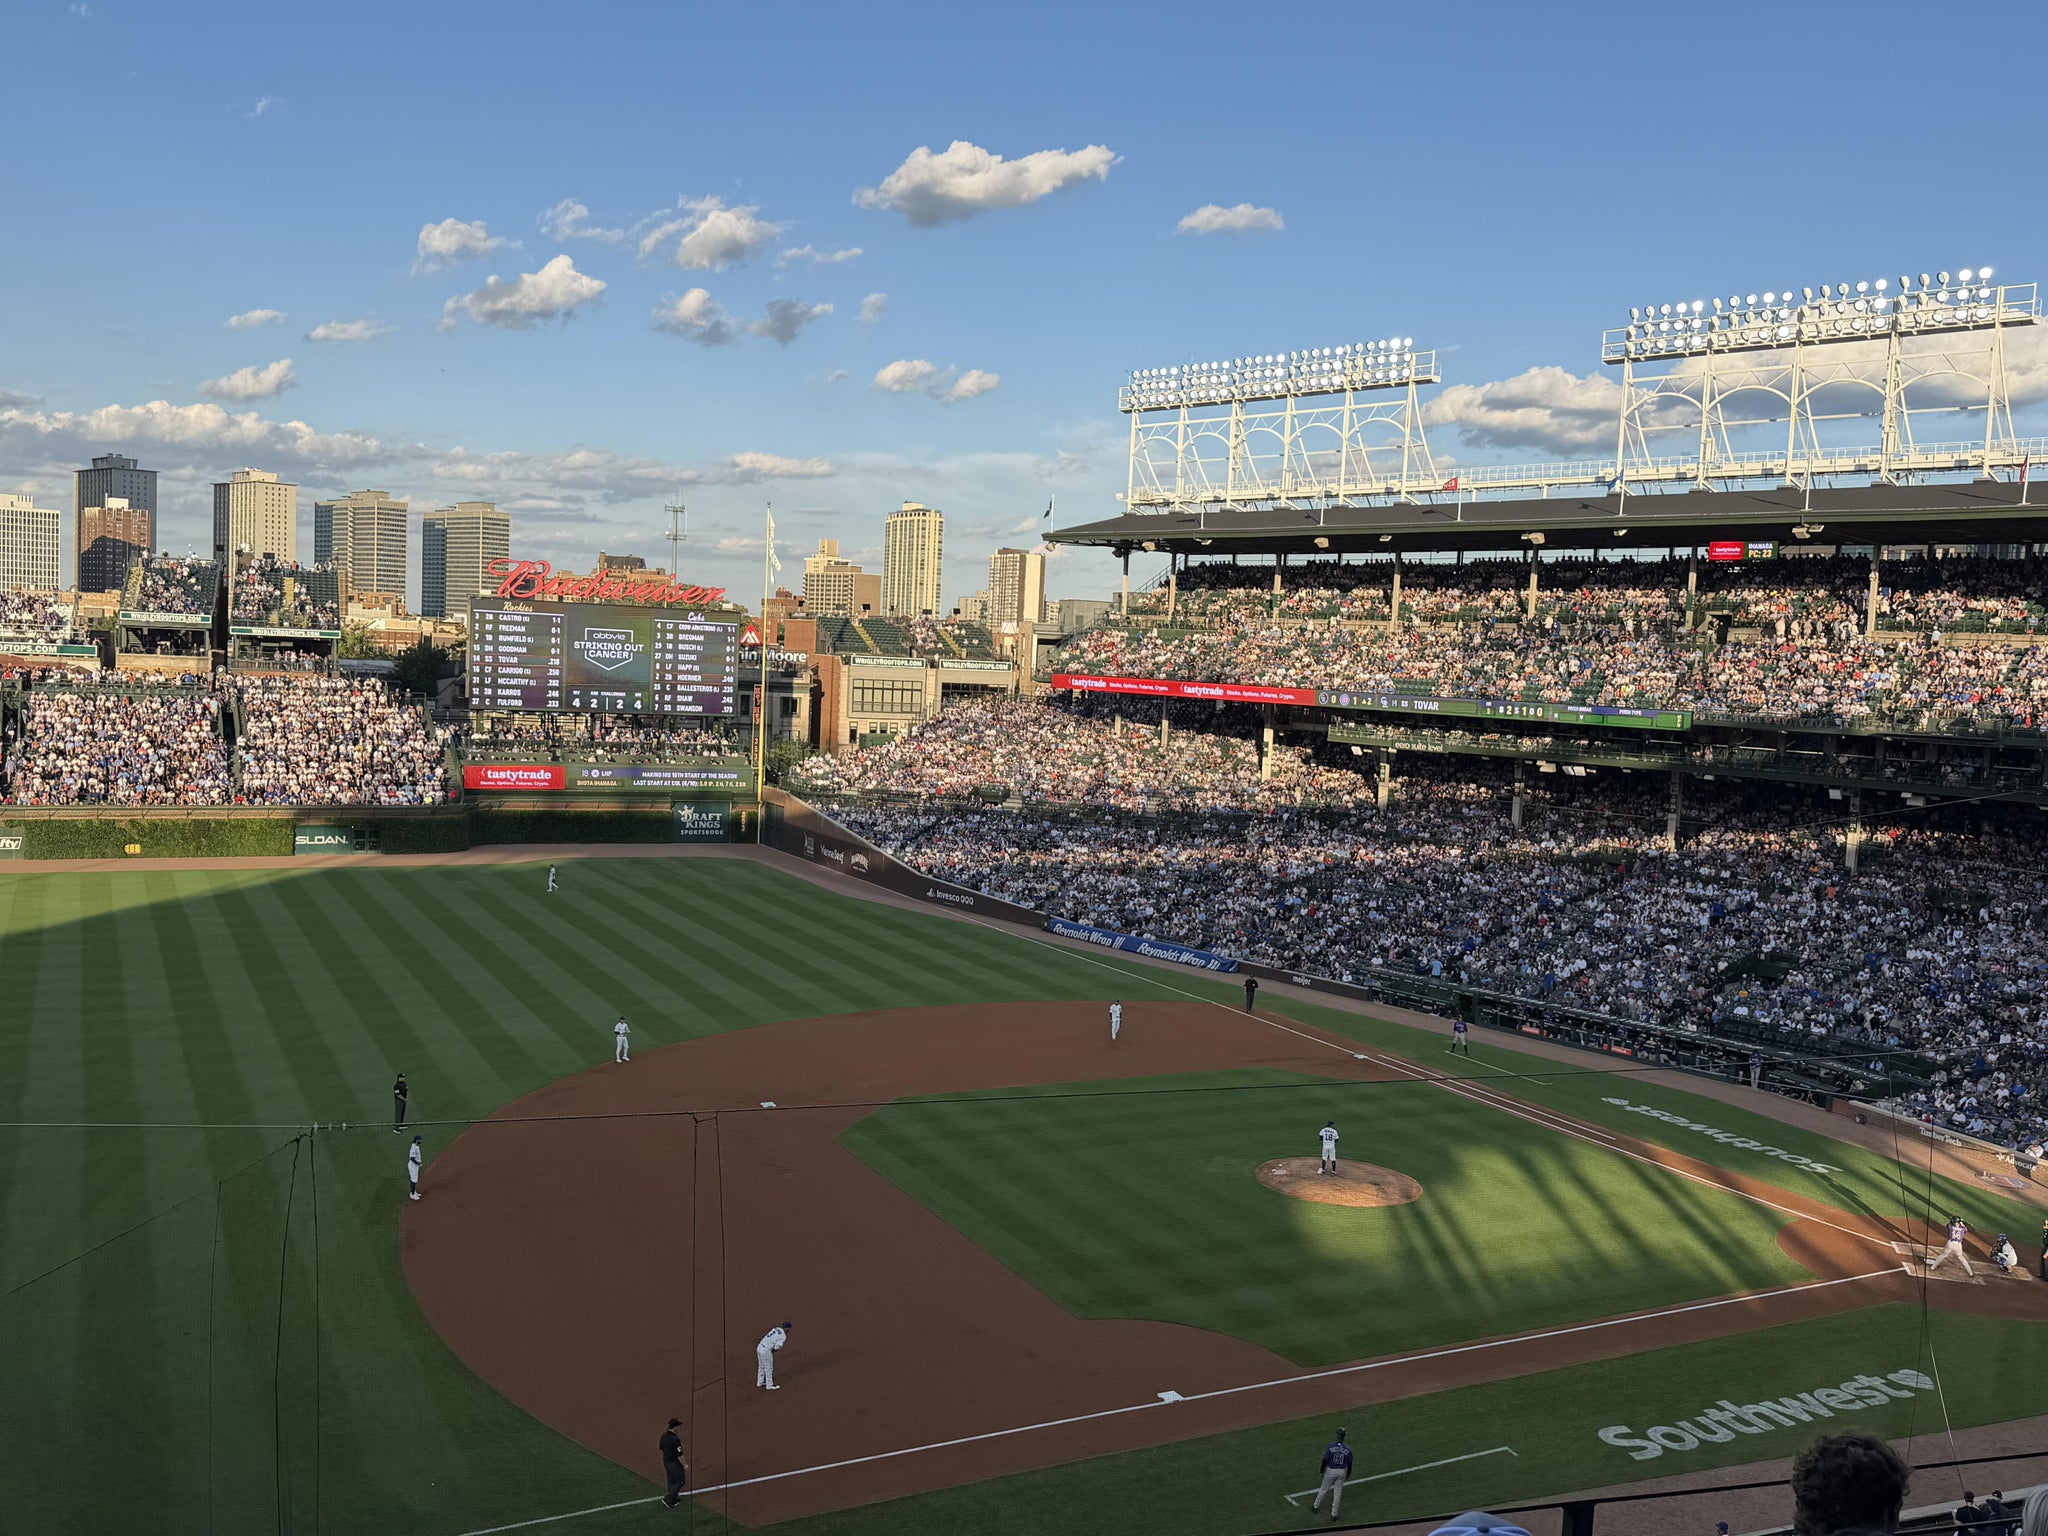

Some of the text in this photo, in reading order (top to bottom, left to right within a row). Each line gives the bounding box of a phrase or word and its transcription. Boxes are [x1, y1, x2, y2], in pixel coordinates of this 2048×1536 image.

[487, 558, 726, 604] Budweiser
[503, 602, 533, 612] Rockies
[688, 612, 705, 621] Cubs
[593, 632, 626, 640] abbvie
[574, 641, 644, 652] STRIKING OUT
[588, 650, 629, 658] CANCER
[766, 649, 806, 662] Moore
[855, 657, 922, 666] WRIGLEYROOFTOPS.COM
[943, 661, 1008, 670] WRIGLEYROOFTOPS.COM
[1072, 678, 1106, 688] tastytrade
[1184, 685, 1223, 696] tastytrade
[572, 698, 642, 709] 4 2 2 4
[1331, 695, 1336, 703] 0
[1353, 697, 1357, 705] 1
[1414, 700, 1439, 711] TOVAR
[1506, 706, 1512, 714] 2
[1522, 706, 1527, 716] 1
[1537, 707, 1543, 716] 0
[1412, 740, 1426, 751] suite
[1428, 744, 1442, 752] level
[487, 770, 551, 781] tastytrade
[681, 813, 722, 822] DRAFT
[937, 890, 959, 902] Invesco
[1053, 923, 1112, 947] Reynolds Wrap
[1137, 942, 1205, 967] Reynolds Wrap
[1624, 1104, 1844, 1174] Southwest
[1920, 1127, 1961, 1147] TimberTech
[2005, 1154, 2036, 1172] Advocate
[1598, 1374, 1916, 1461] Southwest
